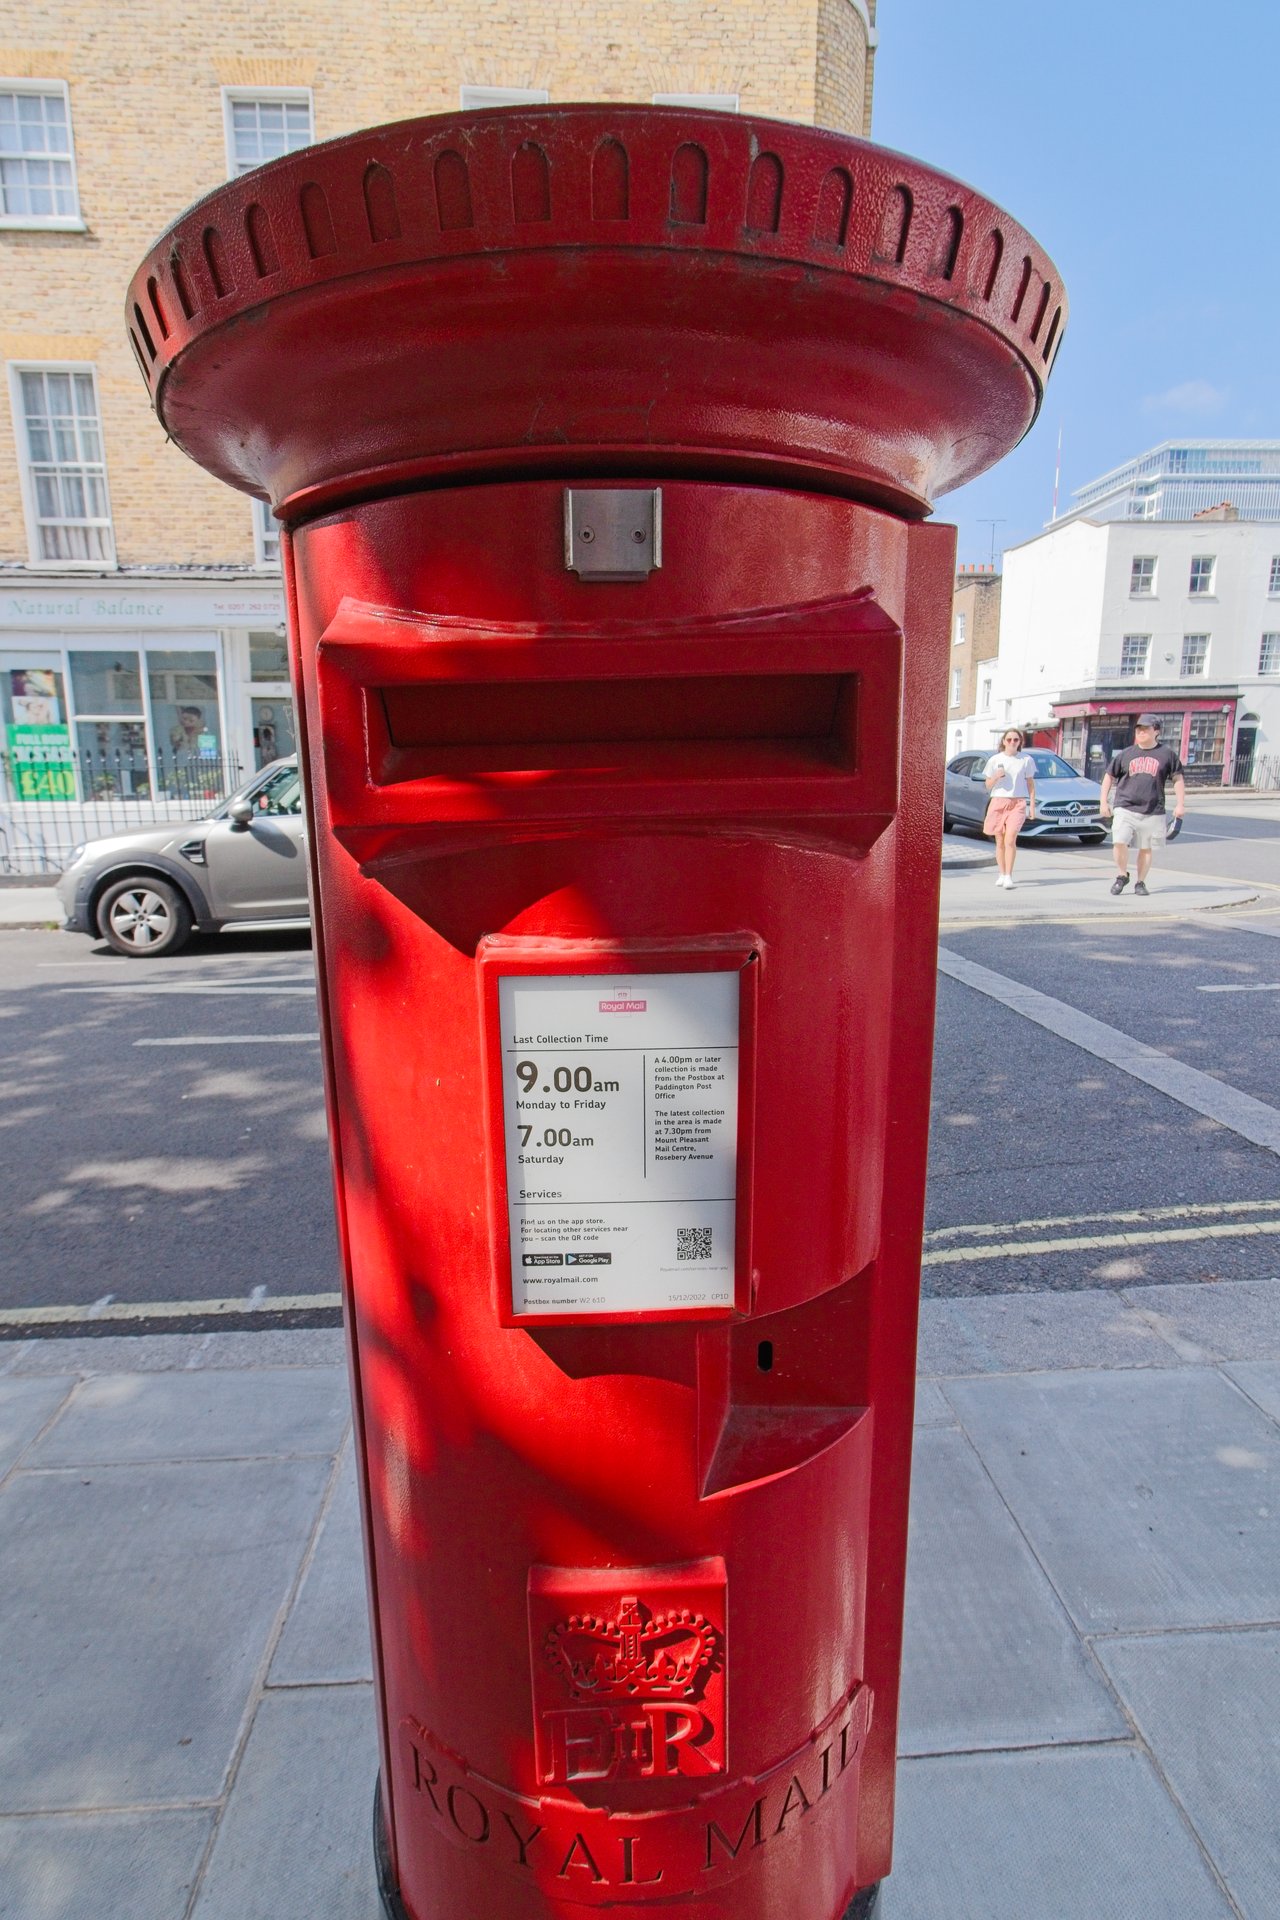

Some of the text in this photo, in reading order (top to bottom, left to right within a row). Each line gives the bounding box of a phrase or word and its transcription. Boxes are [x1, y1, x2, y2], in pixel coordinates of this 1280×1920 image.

[8, 597, 164, 616] Natural Balance
[601, 1002, 645, 1011] Royal Mail
[513, 1034, 609, 1044] Last Collection Time
[661, 1055, 692, 1064] 4.00pm
[516, 1060, 620, 1093] 9.00am
[654, 1083, 695, 1092] Paddington
[654, 1092, 676, 1100] Office
[516, 1099, 606, 1111] Monday to Friday
[517, 1124, 594, 1147] 7.00am
[664, 1127, 693, 1136] 7.30pm
[518, 1154, 564, 1165] Saturday
[519, 1189, 562, 1198] Services
[534, 1227, 561, 1235] locating
[522, 1276, 599, 1285] www.royalmail.com
[668, 1293, 706, 1301] 15/12/2022
[408, 1719, 860, 1886] ROYAL MAIL
